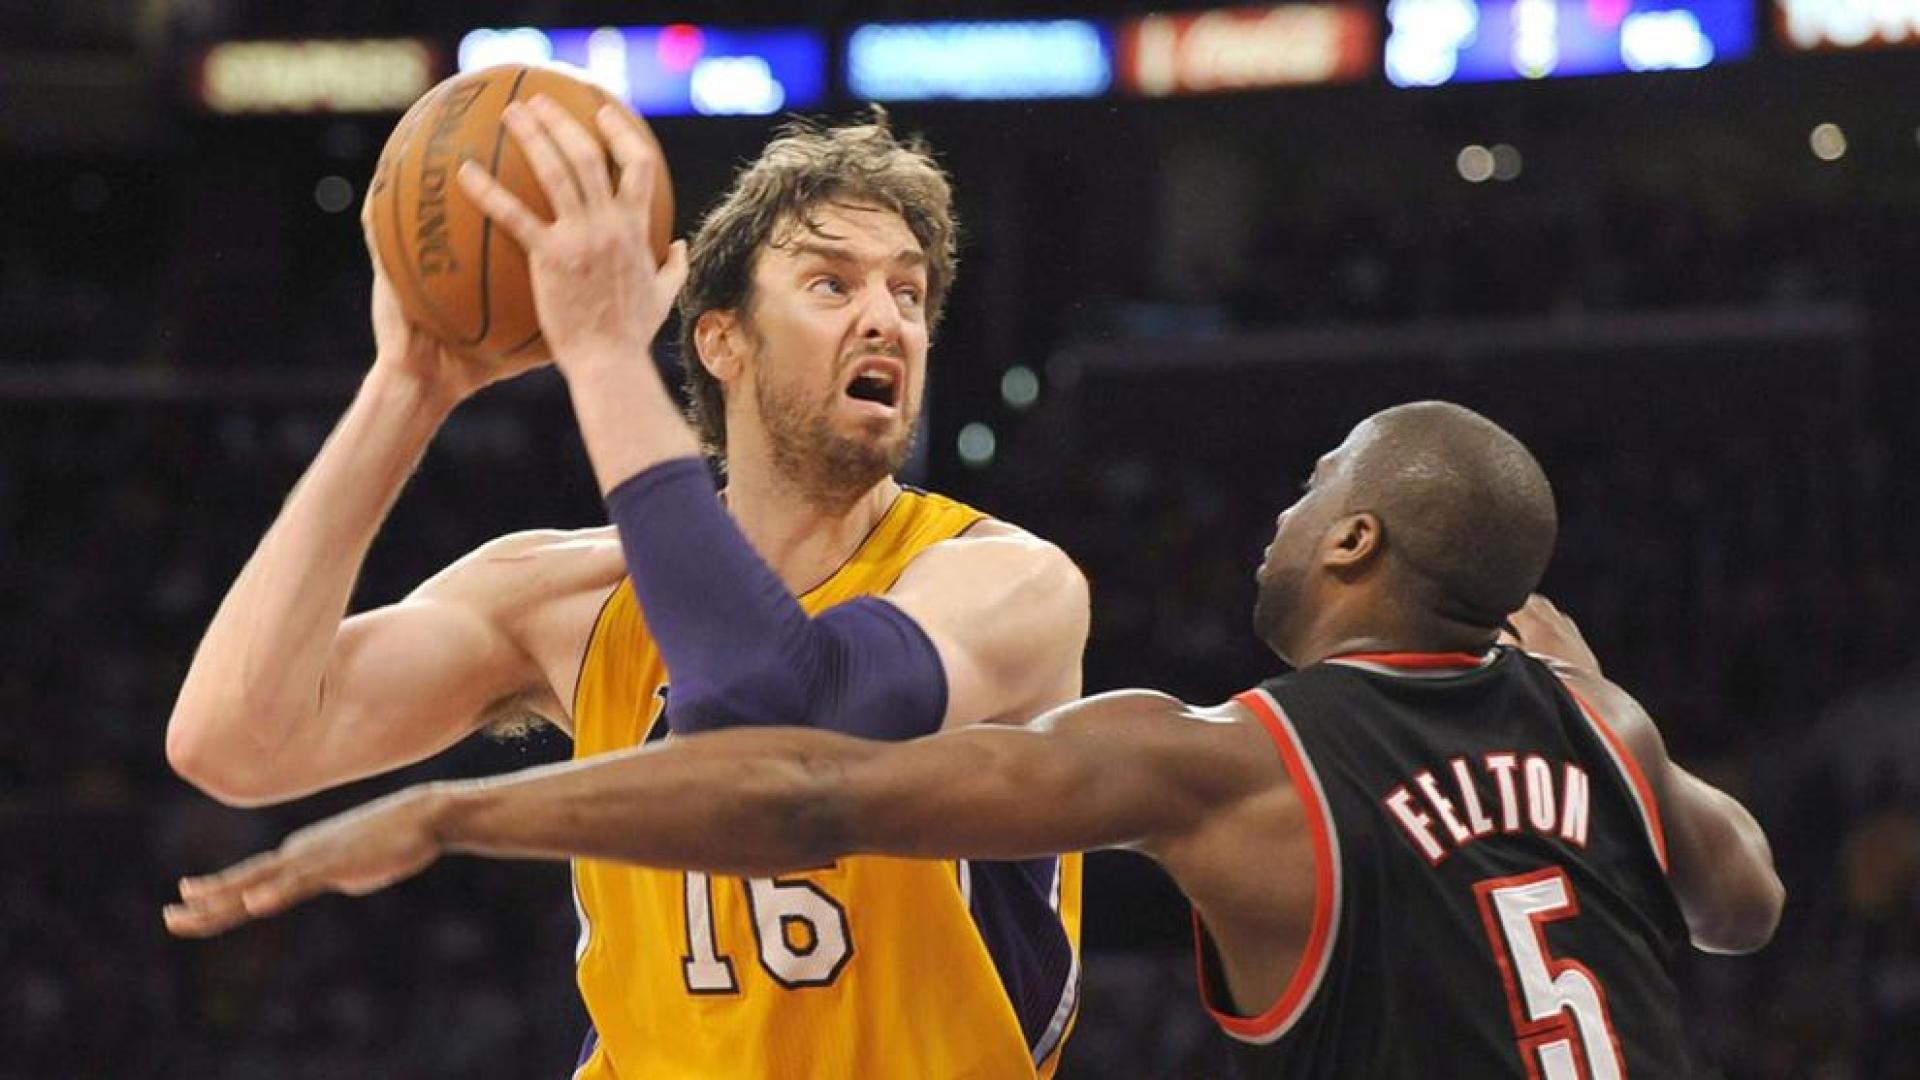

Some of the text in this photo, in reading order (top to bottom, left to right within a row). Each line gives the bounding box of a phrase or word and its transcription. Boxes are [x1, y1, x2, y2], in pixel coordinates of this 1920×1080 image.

[1380, 752, 1592, 869] FELTON
[681, 860, 854, 995] 16
[1471, 865, 1630, 1080] 5
